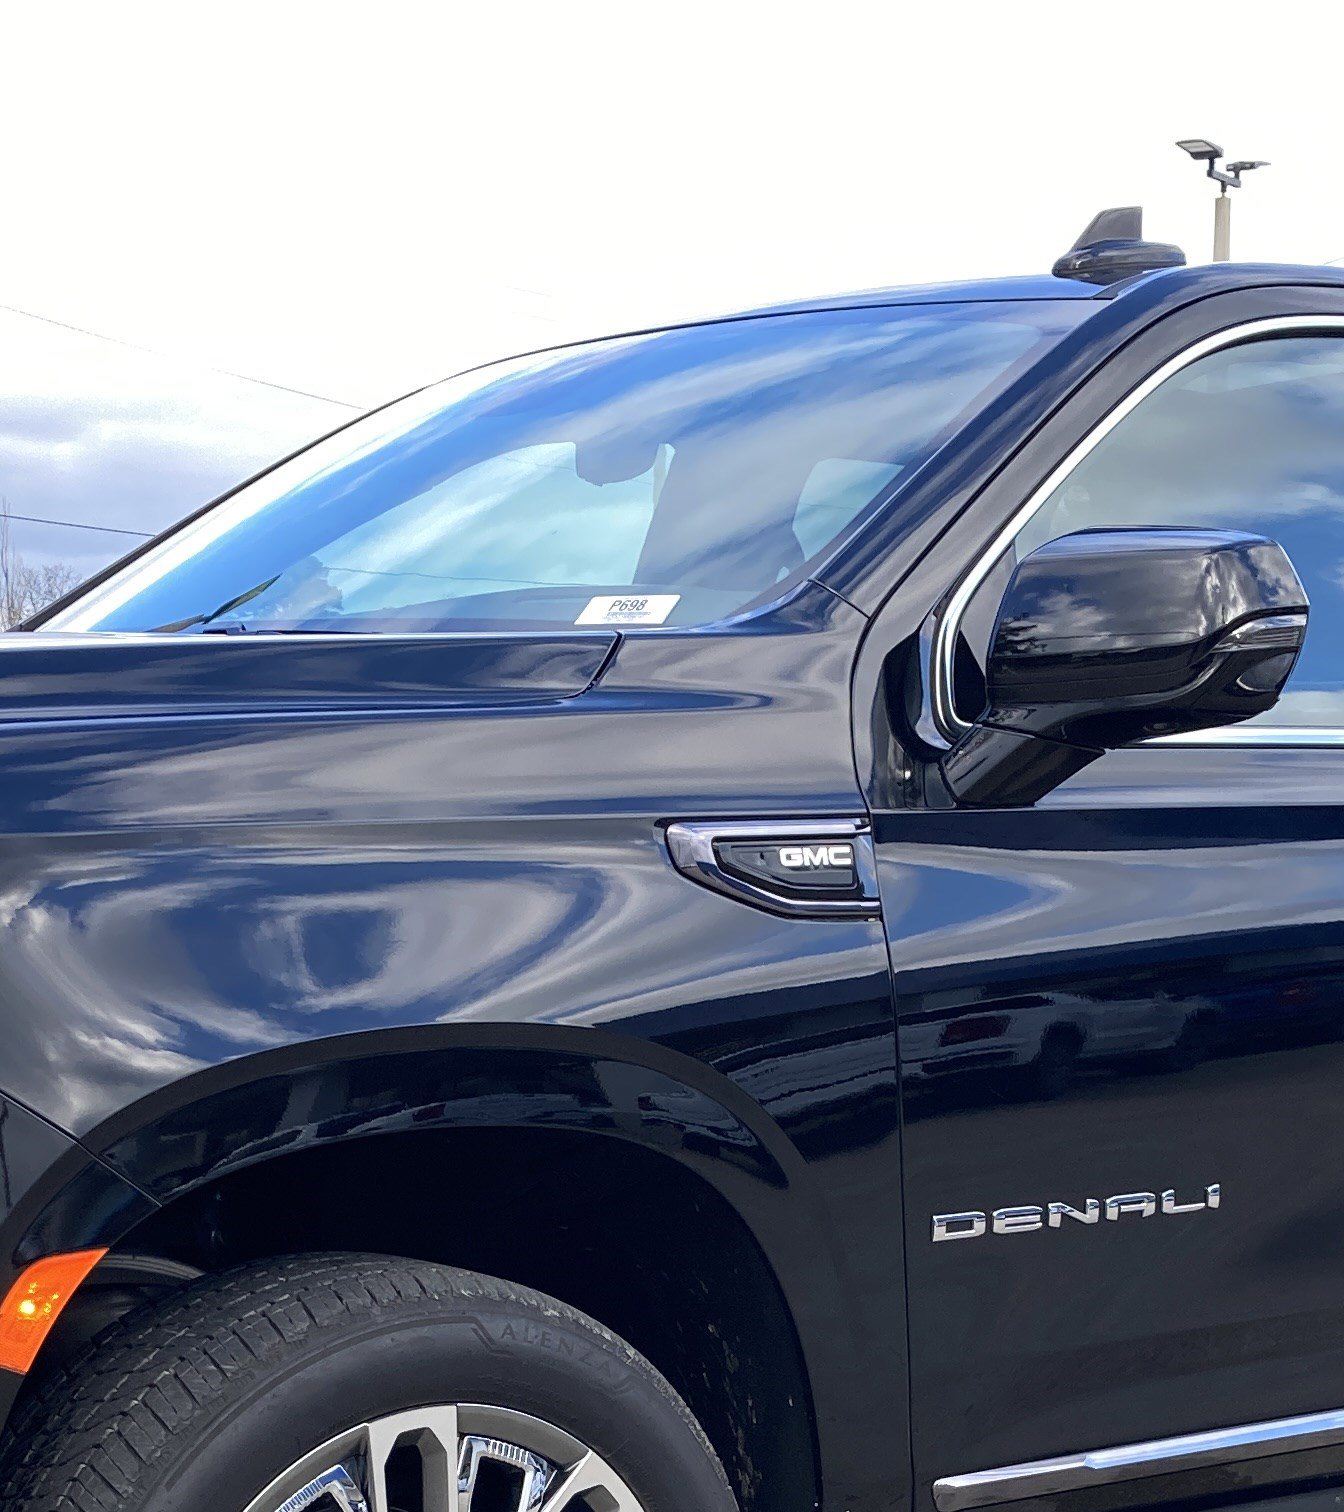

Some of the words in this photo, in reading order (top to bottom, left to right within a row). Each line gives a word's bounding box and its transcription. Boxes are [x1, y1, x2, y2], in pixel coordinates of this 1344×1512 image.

[608, 599, 649, 612] P698
[779, 846, 852, 867] GMC
[931, 1183, 1221, 1242] DENALI
[501, 1320, 613, 1378] ALENZA
